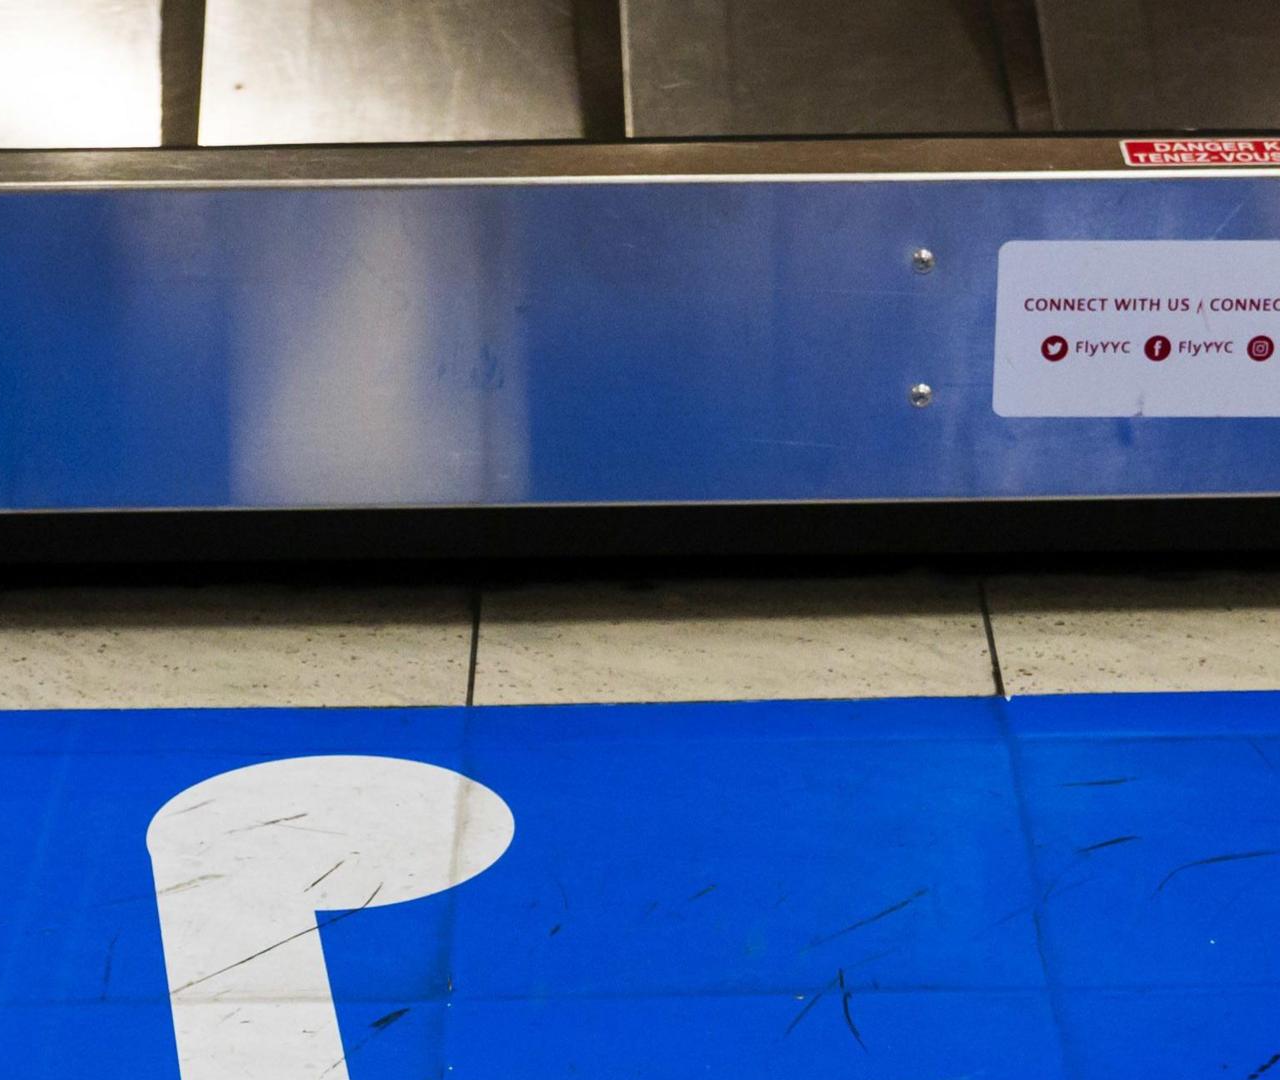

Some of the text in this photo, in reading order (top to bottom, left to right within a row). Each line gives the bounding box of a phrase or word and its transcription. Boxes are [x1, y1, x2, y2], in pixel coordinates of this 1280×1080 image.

[1153, 142, 1255, 152] DANGER
[1024, 298, 1109, 312] CONNECT
[1114, 298, 1161, 312] WITH
[1168, 298, 1190, 312] US
[1075, 340, 1131, 357] FlyYYC
[1179, 340, 1234, 357] FlyYYC
